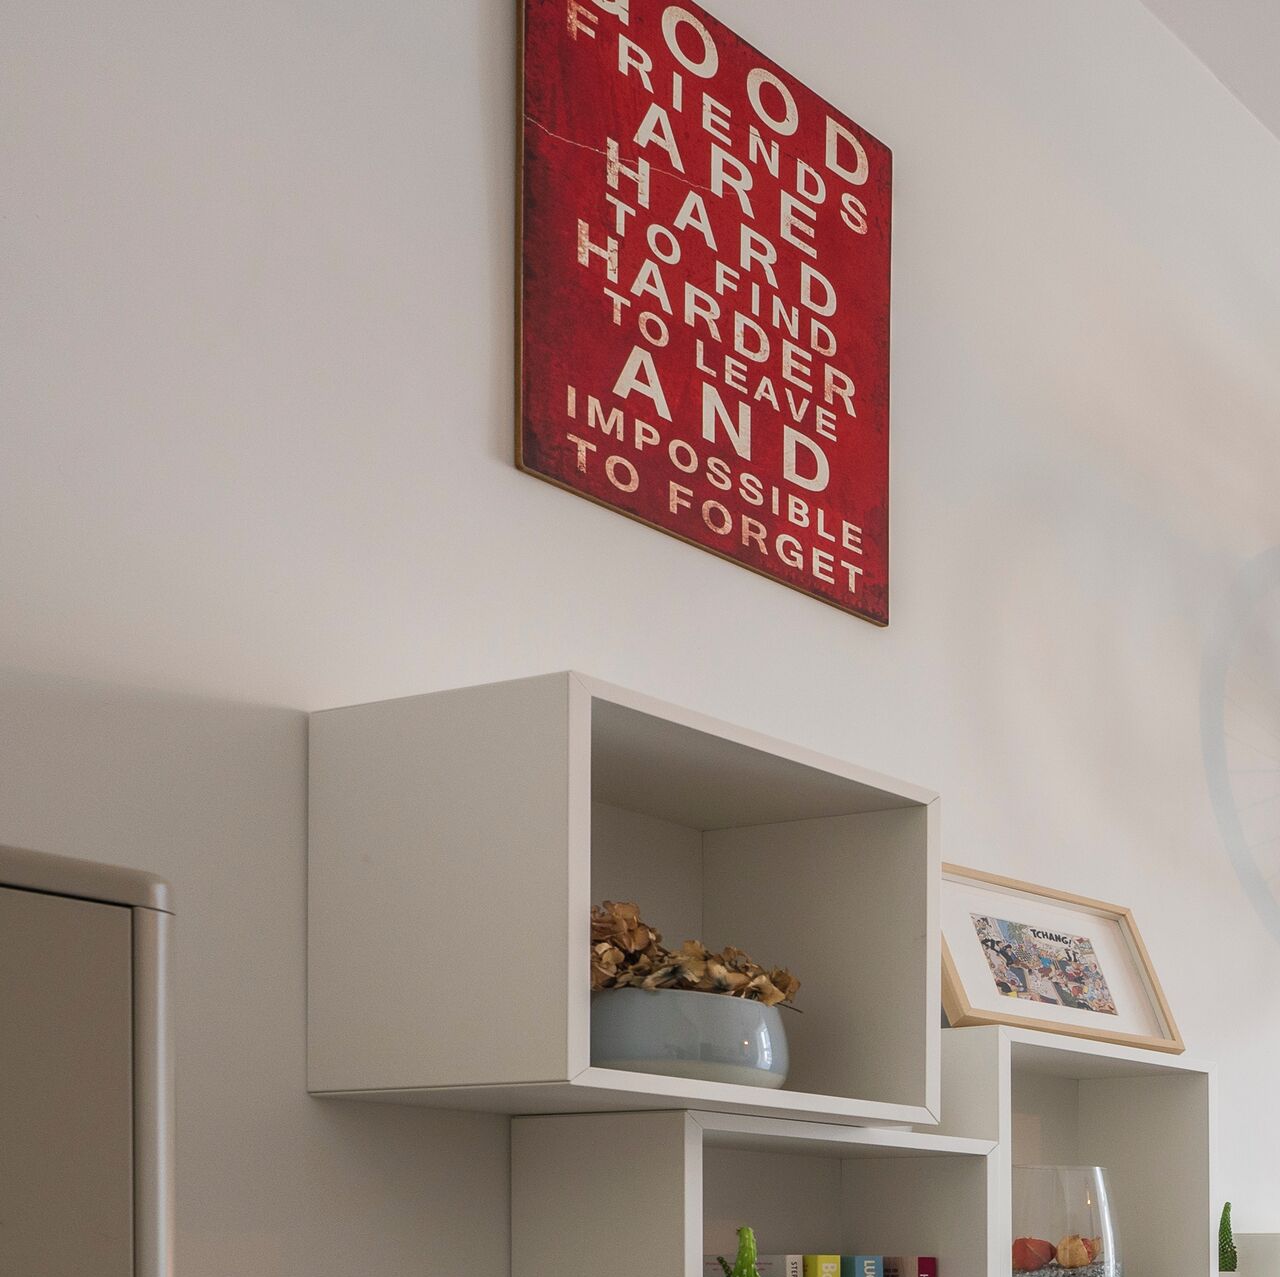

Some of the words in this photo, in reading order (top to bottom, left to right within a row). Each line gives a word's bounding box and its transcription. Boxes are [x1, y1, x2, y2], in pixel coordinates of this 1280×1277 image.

[567, 0, 868, 235] FRIENDS
[633, 102, 816, 258] ARE
[606, 137, 837, 318] HARD
[606, 194, 681, 265] TO
[715, 261, 837, 358] FIND
[577, 218, 856, 418] HARDER
[604, 286, 669, 348] TO
[696, 340, 838, 442] LEAVE
[567, 385, 863, 555] IMPOSSIBLE
[612, 345, 830, 492] AND
[566, 432, 639, 494] TO
[669, 481, 863, 594] FORGET
[1029, 928, 1072, 948] TCHANG!
